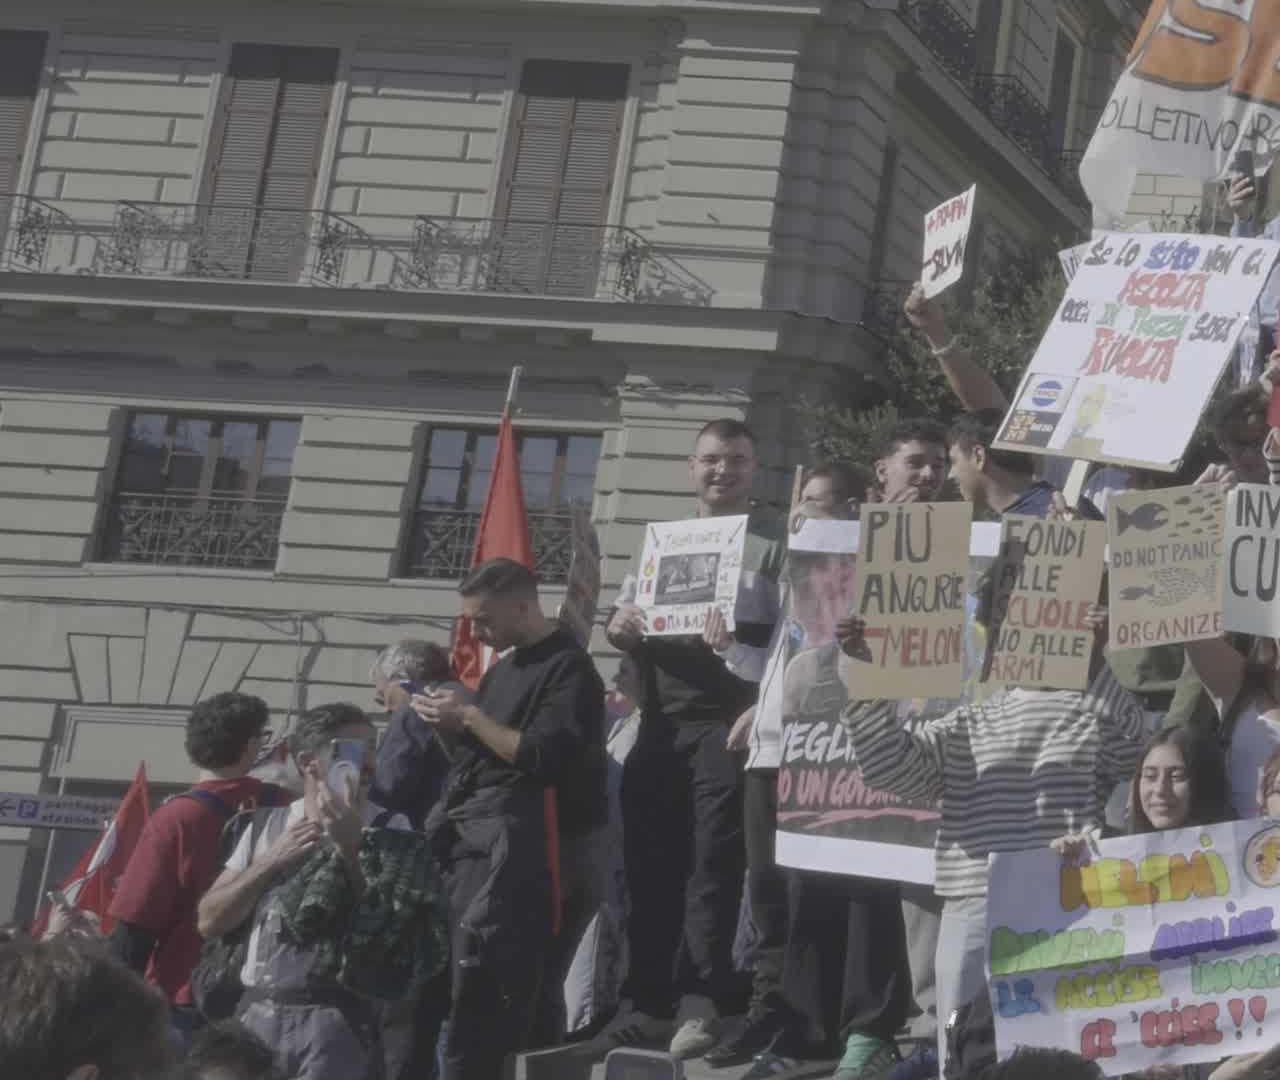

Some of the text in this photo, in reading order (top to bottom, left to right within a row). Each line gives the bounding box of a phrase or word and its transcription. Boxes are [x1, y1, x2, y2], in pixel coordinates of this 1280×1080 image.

[865, 504, 933, 563] PIÙ
[1112, 539, 1223, 570] DO NOT PANIC
[1005, 599, 1091, 632] CUOLE
[1116, 611, 1223, 646] ORGANIZE
[1028, 632, 1087, 656] ALLE
[989, 654, 1046, 682] ARMI
